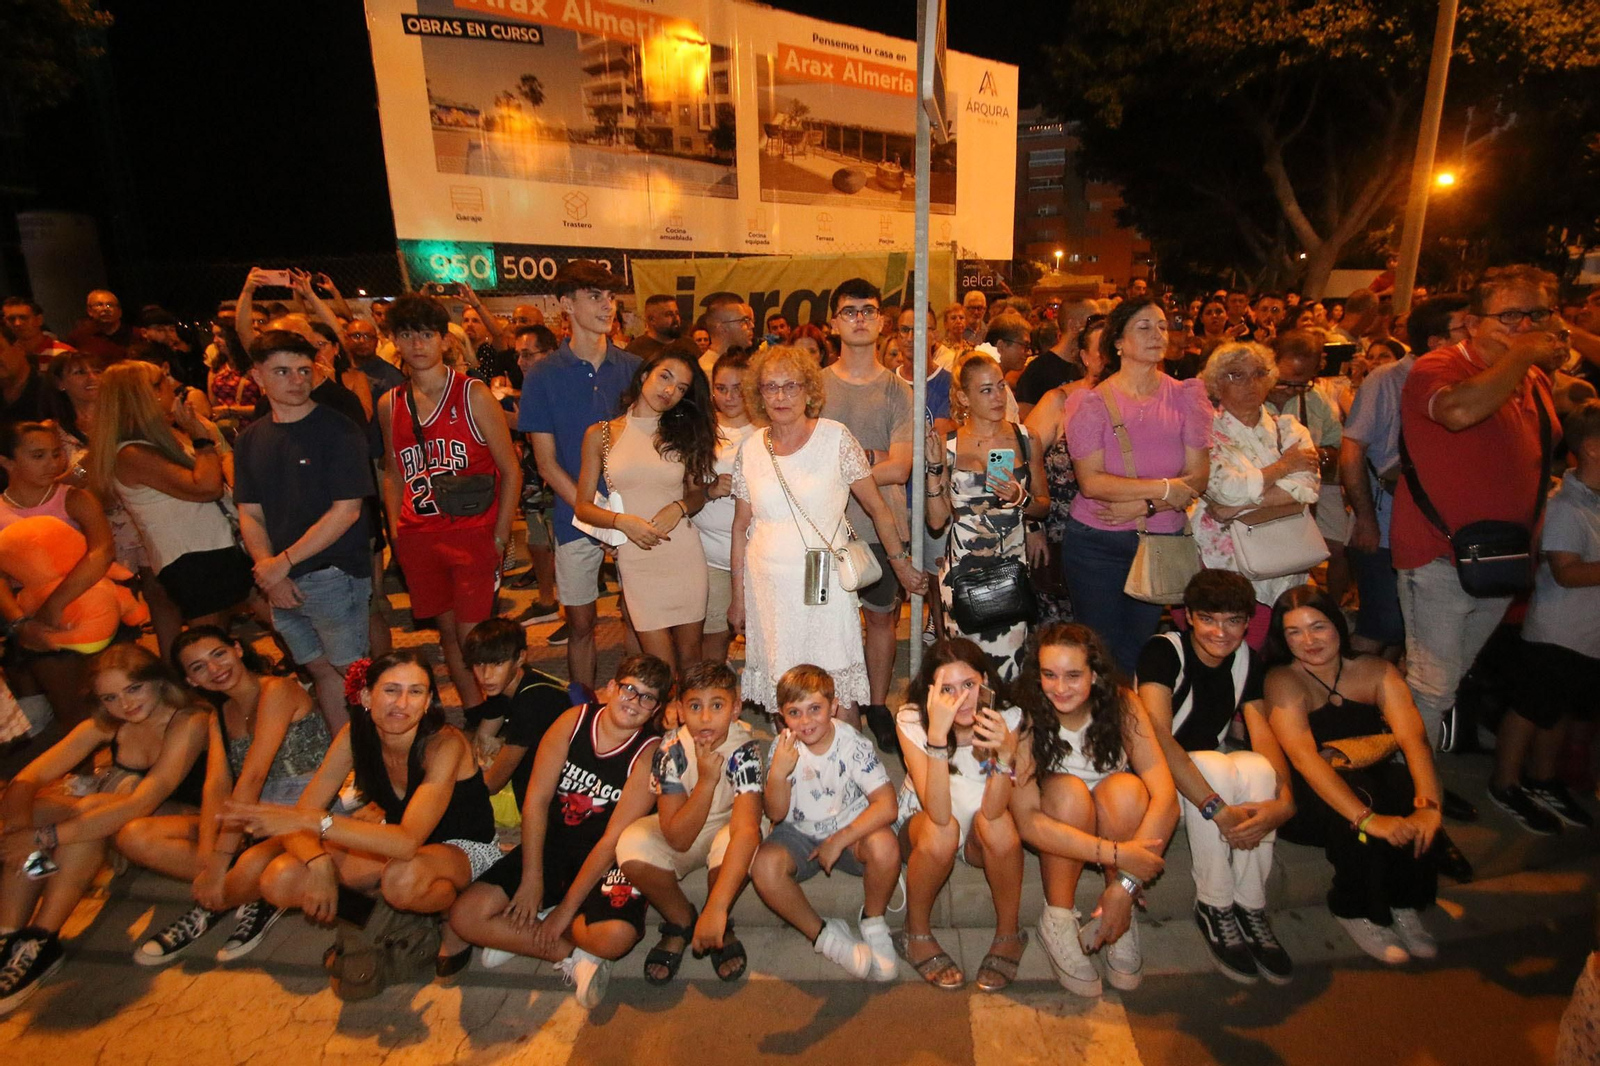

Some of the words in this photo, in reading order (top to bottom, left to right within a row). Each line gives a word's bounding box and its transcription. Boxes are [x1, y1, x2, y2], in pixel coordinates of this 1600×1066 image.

[406, 18, 463, 36] OBRAS
[466, 22, 487, 37] EN
[490, 24, 540, 43] CURSO
[812, 33, 860, 53] Pensemos
[862, 45, 872, 55] tu
[874, 48, 894, 60] casa
[896, 52, 907, 62] en
[784, 48, 834, 78] Arax
[842, 61, 914, 93] Almería
[455, 214, 483, 223] Garaje
[562, 220, 592, 229] Trastero
[659, 234, 693, 242] amueblada
[665, 227, 687, 235] Cocina
[745, 238, 770, 246] equipada
[429, 254, 491, 279] 950
[502, 255, 557, 280] 500
[962, 271, 993, 287] aelca
[399, 438, 468, 483] BULLS
